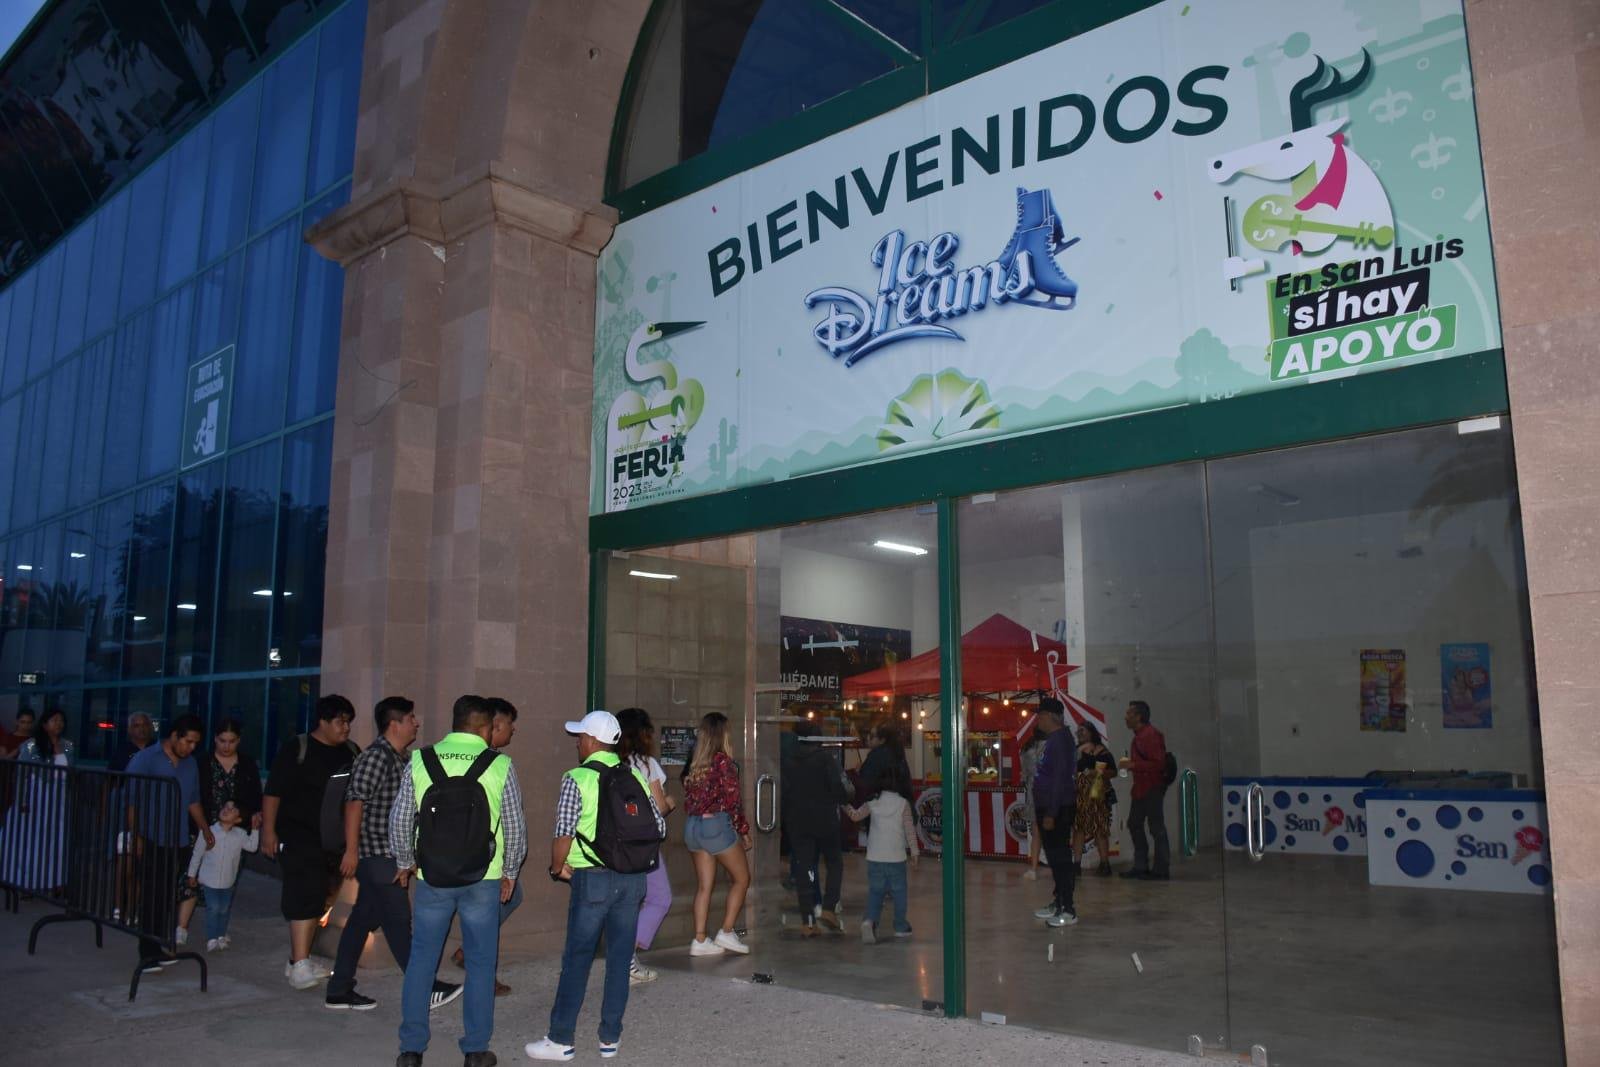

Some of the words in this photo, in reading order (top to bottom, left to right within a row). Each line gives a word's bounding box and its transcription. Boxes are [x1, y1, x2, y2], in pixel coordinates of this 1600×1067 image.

[708, 65, 1230, 298] BIENVENIDOS
[871, 230, 960, 292] Ice
[1274, 272, 1313, 299] En
[1320, 254, 1384, 289] San
[1392, 234, 1465, 273] Luis
[804, 249, 1036, 366] Dreams
[1293, 294, 1327, 331] sí
[1337, 280, 1419, 322] hay
[613, 444, 685, 483] FERIA
[613, 483, 642, 501] 2023
[1285, 813, 1320, 831] San
[1457, 834, 1508, 859] San
